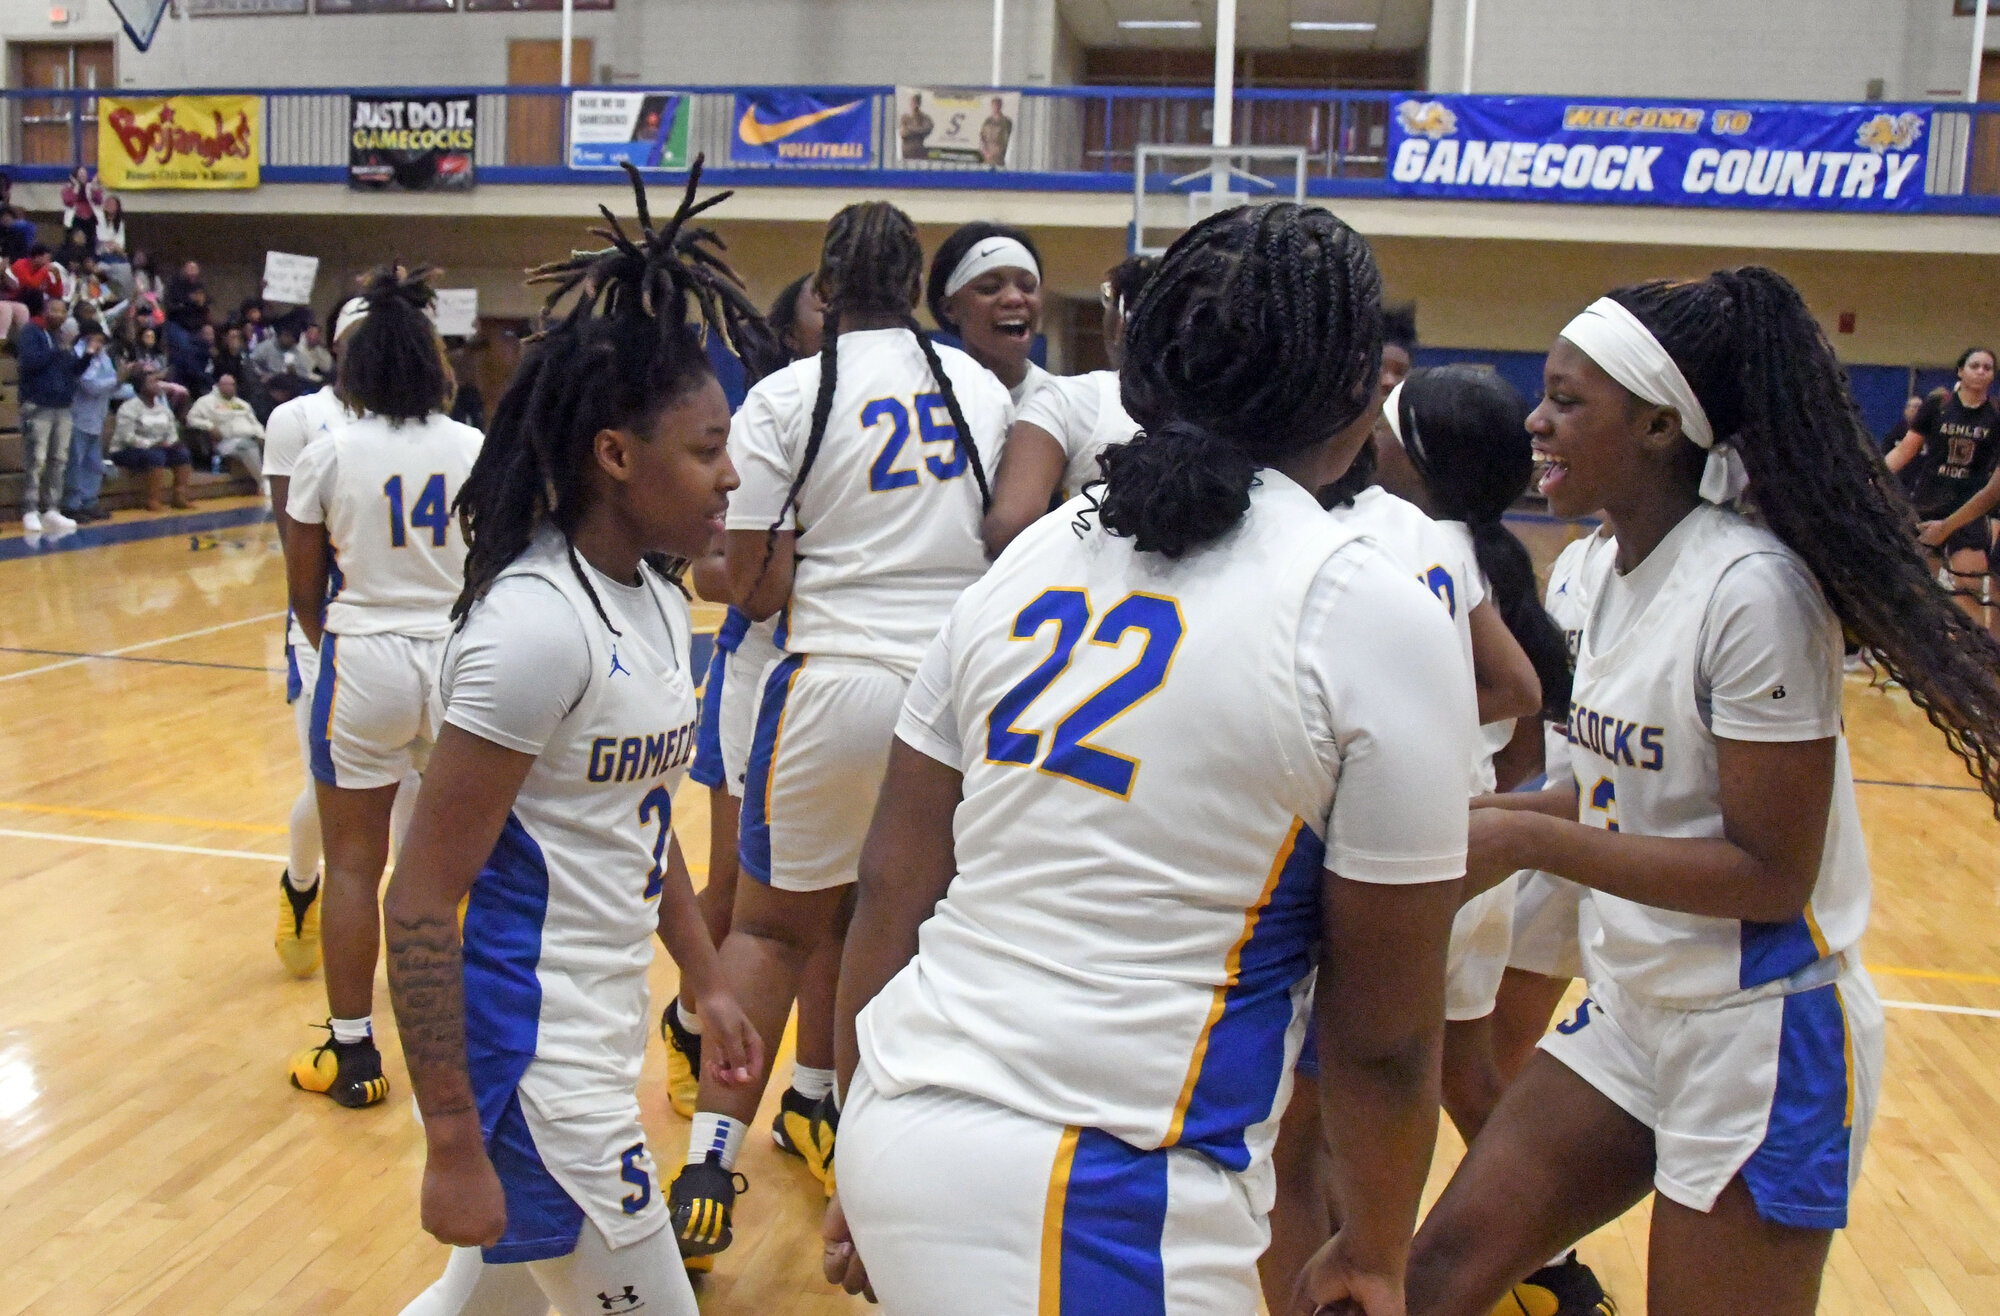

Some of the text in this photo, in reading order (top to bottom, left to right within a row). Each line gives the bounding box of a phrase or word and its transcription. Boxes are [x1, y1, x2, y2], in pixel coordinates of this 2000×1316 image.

[353, 101, 404, 128] JUST
[407, 101, 443, 128] DO
[1564, 106, 1751, 135] WELCOME TO
[352, 129, 473, 150] GAMECOCKS
[778, 143, 863, 158] VOLLEYBALL
[1392, 138, 1920, 199] GAMECOCK COUNTRY
[859, 390, 970, 494] 25
[1940, 423, 1990, 439] ASHLEY
[1938, 465, 1969, 479] RIDG
[383, 472, 451, 549] 14
[983, 586, 1188, 803] 22
[620, 1142, 650, 1214] S
